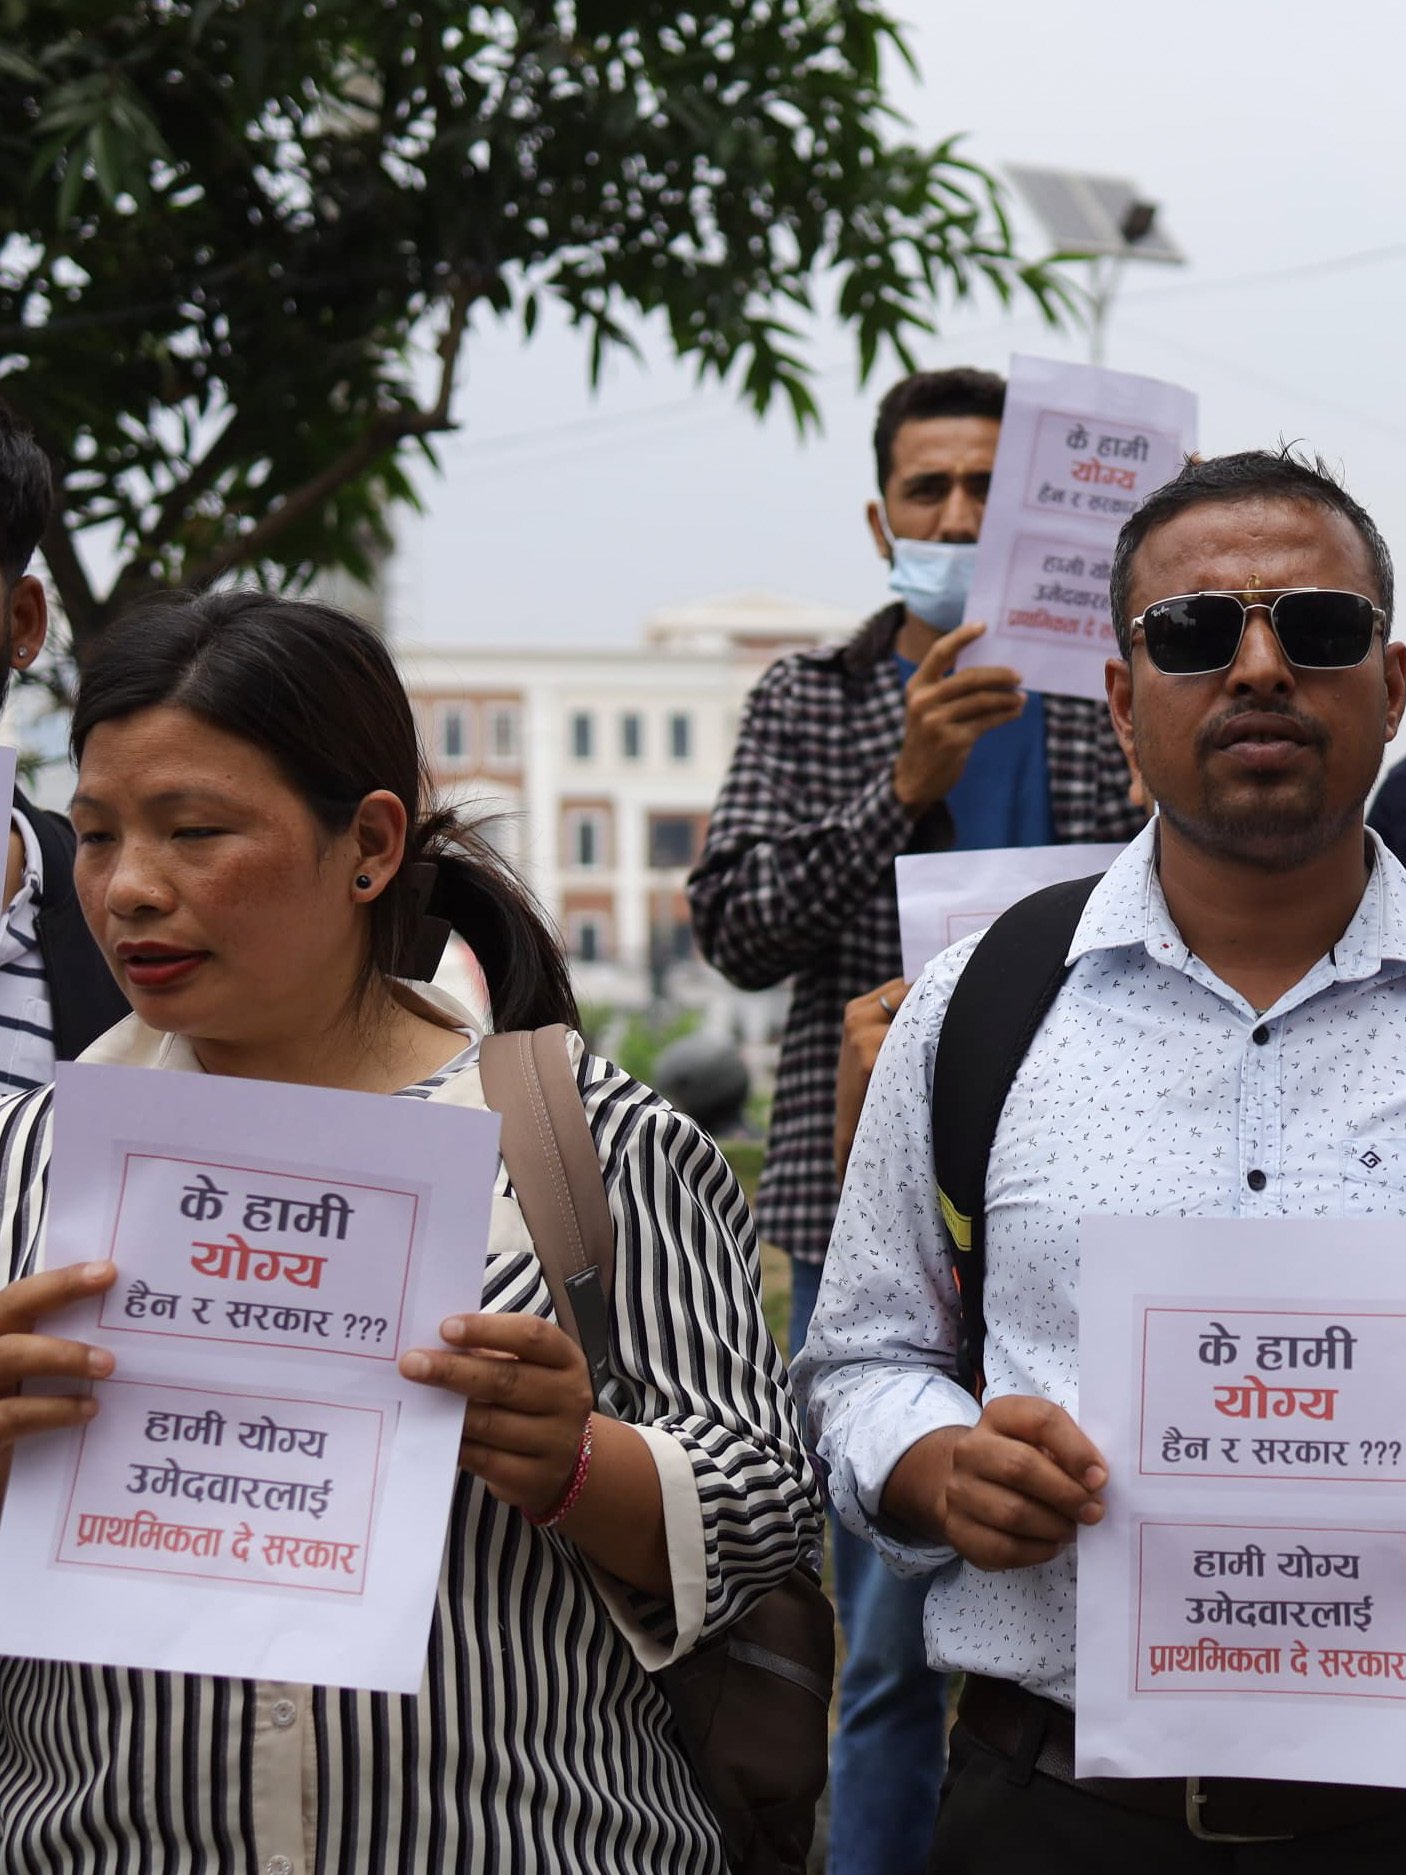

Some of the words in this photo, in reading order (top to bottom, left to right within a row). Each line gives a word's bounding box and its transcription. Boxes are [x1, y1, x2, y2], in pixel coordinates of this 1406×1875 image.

[180, 1174, 229, 1223] के
[243, 1192, 355, 1241] हामी
[190, 1232, 328, 1289] योग्य
[123, 1280, 178, 1320] हैन
[190, 1295, 218, 1326] र
[224, 1302, 335, 1337] सरकार
[343, 1312, 388, 1343] ???
[1199, 1322, 1240, 1367] के
[1256, 1325, 1357, 1371] हामी
[1214, 1375, 1339, 1420] योग्य
[145, 1409, 226, 1447] हामी
[237, 1415, 328, 1460] योग्य
[1162, 1426, 1209, 1463] हैन
[1221, 1438, 1241, 1463] र
[1252, 1438, 1349, 1467] सरकार
[1360, 1440, 1401, 1466] ???
[125, 1458, 334, 1520] उमेदवारलाई
[76, 1510, 222, 1558] प्राथमिकता
[231, 1522, 254, 1562] दे
[261, 1533, 363, 1576] सरकार
[1193, 1545, 1266, 1579] हामी
[1277, 1546, 1360, 1580] योग्य
[1185, 1590, 1374, 1629] उमेदवारलाई
[1149, 1638, 1281, 1677] प्राथमिकता
[1290, 1641, 1308, 1678] दे
